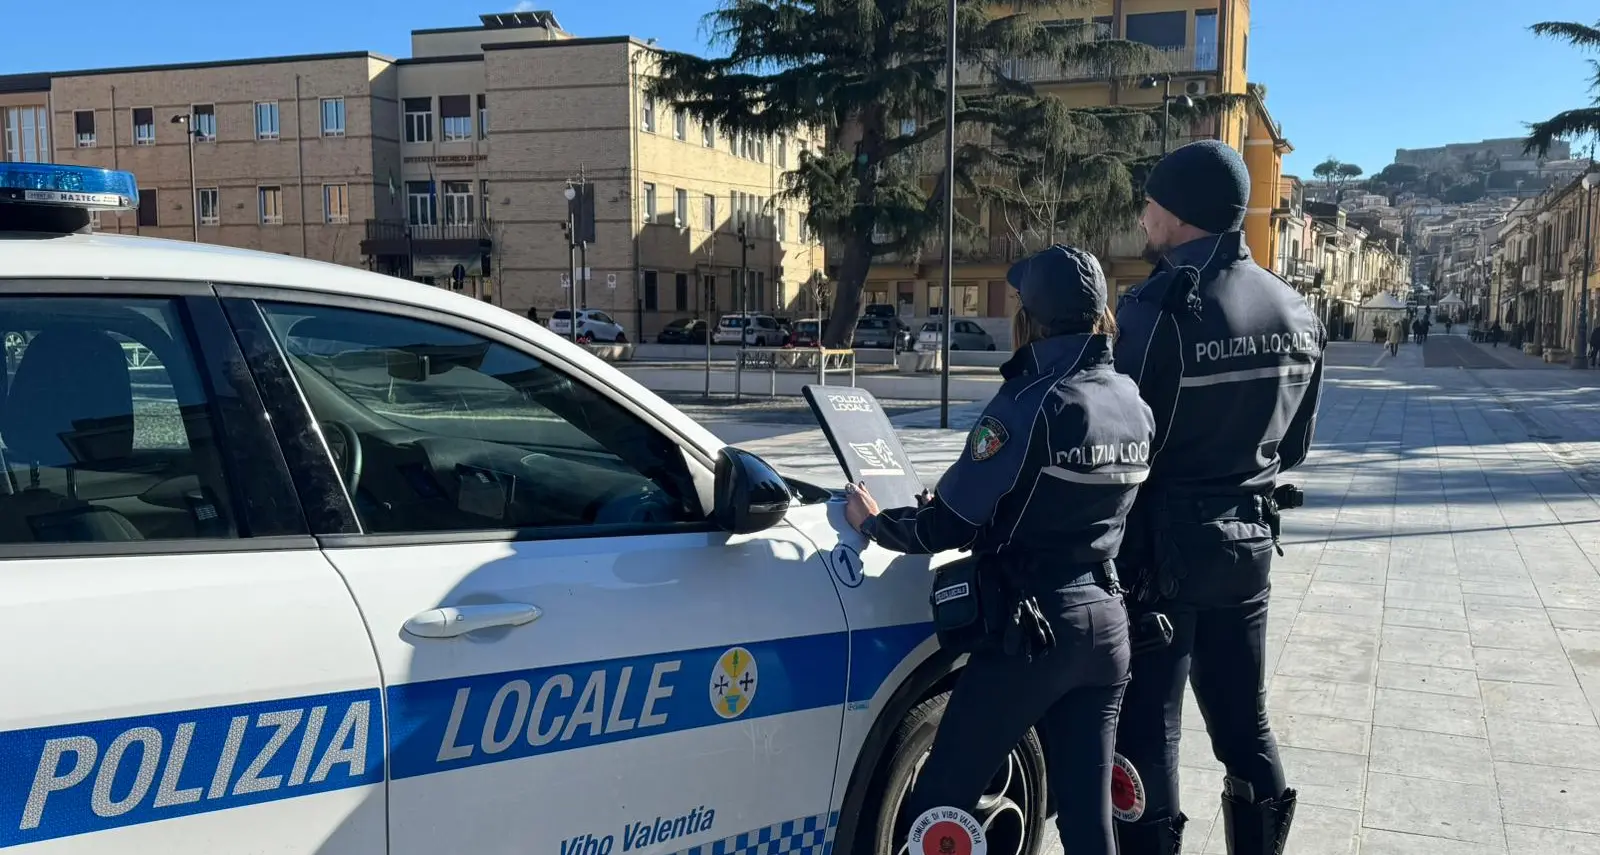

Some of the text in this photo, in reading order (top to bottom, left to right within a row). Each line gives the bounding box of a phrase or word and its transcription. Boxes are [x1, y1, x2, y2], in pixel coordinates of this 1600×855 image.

[60, 193, 97, 202] HAZTEC
[1195, 332, 1313, 362] POLIZIA LOCALE
[827, 394, 869, 404] POLIZIA
[832, 403, 873, 412] LOCALE
[1056, 441, 1151, 467] POLIZIA LOC
[838, 549, 857, 582] 1
[19, 660, 682, 830] POLIZIA LOCALE
[623, 805, 715, 852] Valentia
[912, 810, 982, 844] COMUNE DI VIBO VALENTIA
